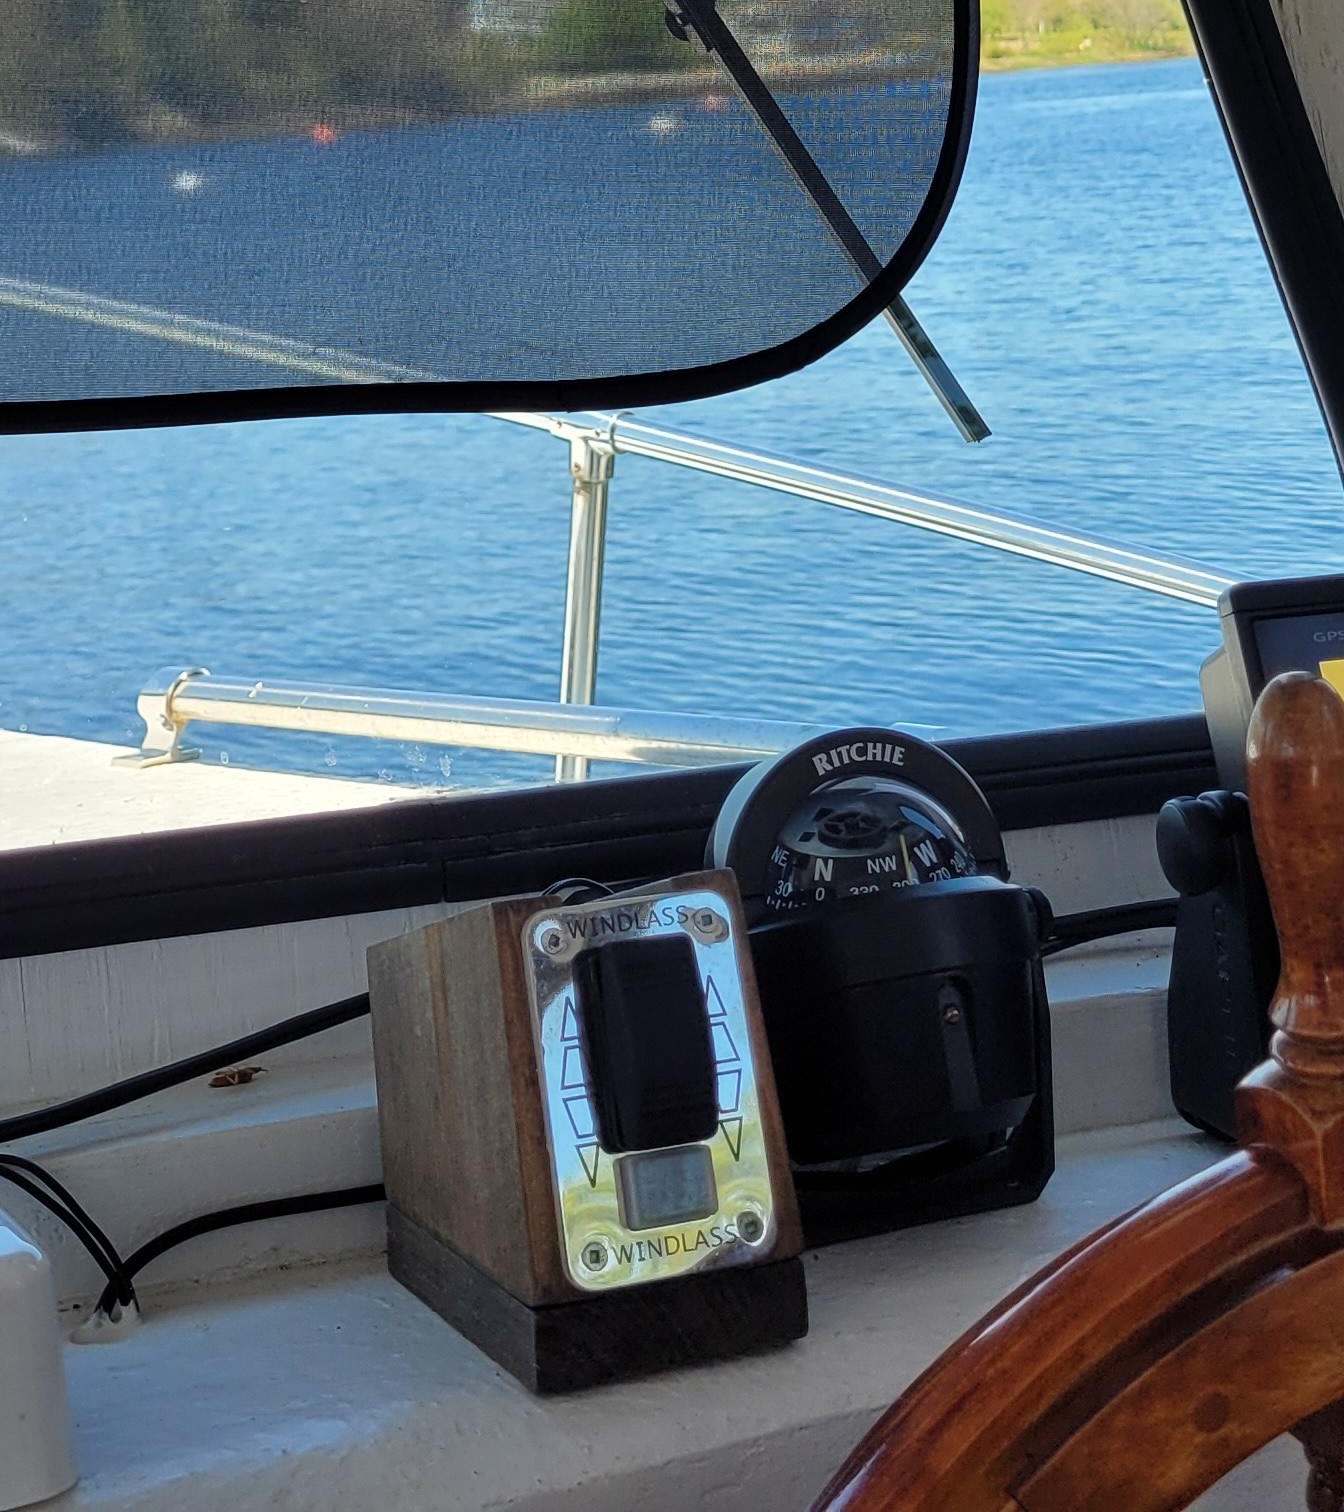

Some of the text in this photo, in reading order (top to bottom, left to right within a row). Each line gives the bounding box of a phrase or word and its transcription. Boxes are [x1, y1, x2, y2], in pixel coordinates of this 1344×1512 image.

[812, 742, 906, 777] RITCHIE
[771, 839, 939, 882] NE N NW W
[774, 879, 793, 898] 30
[815, 887, 826, 901] 0
[566, 904, 689, 939] WINDLASS
[611, 1223, 739, 1265] WINDLASS
